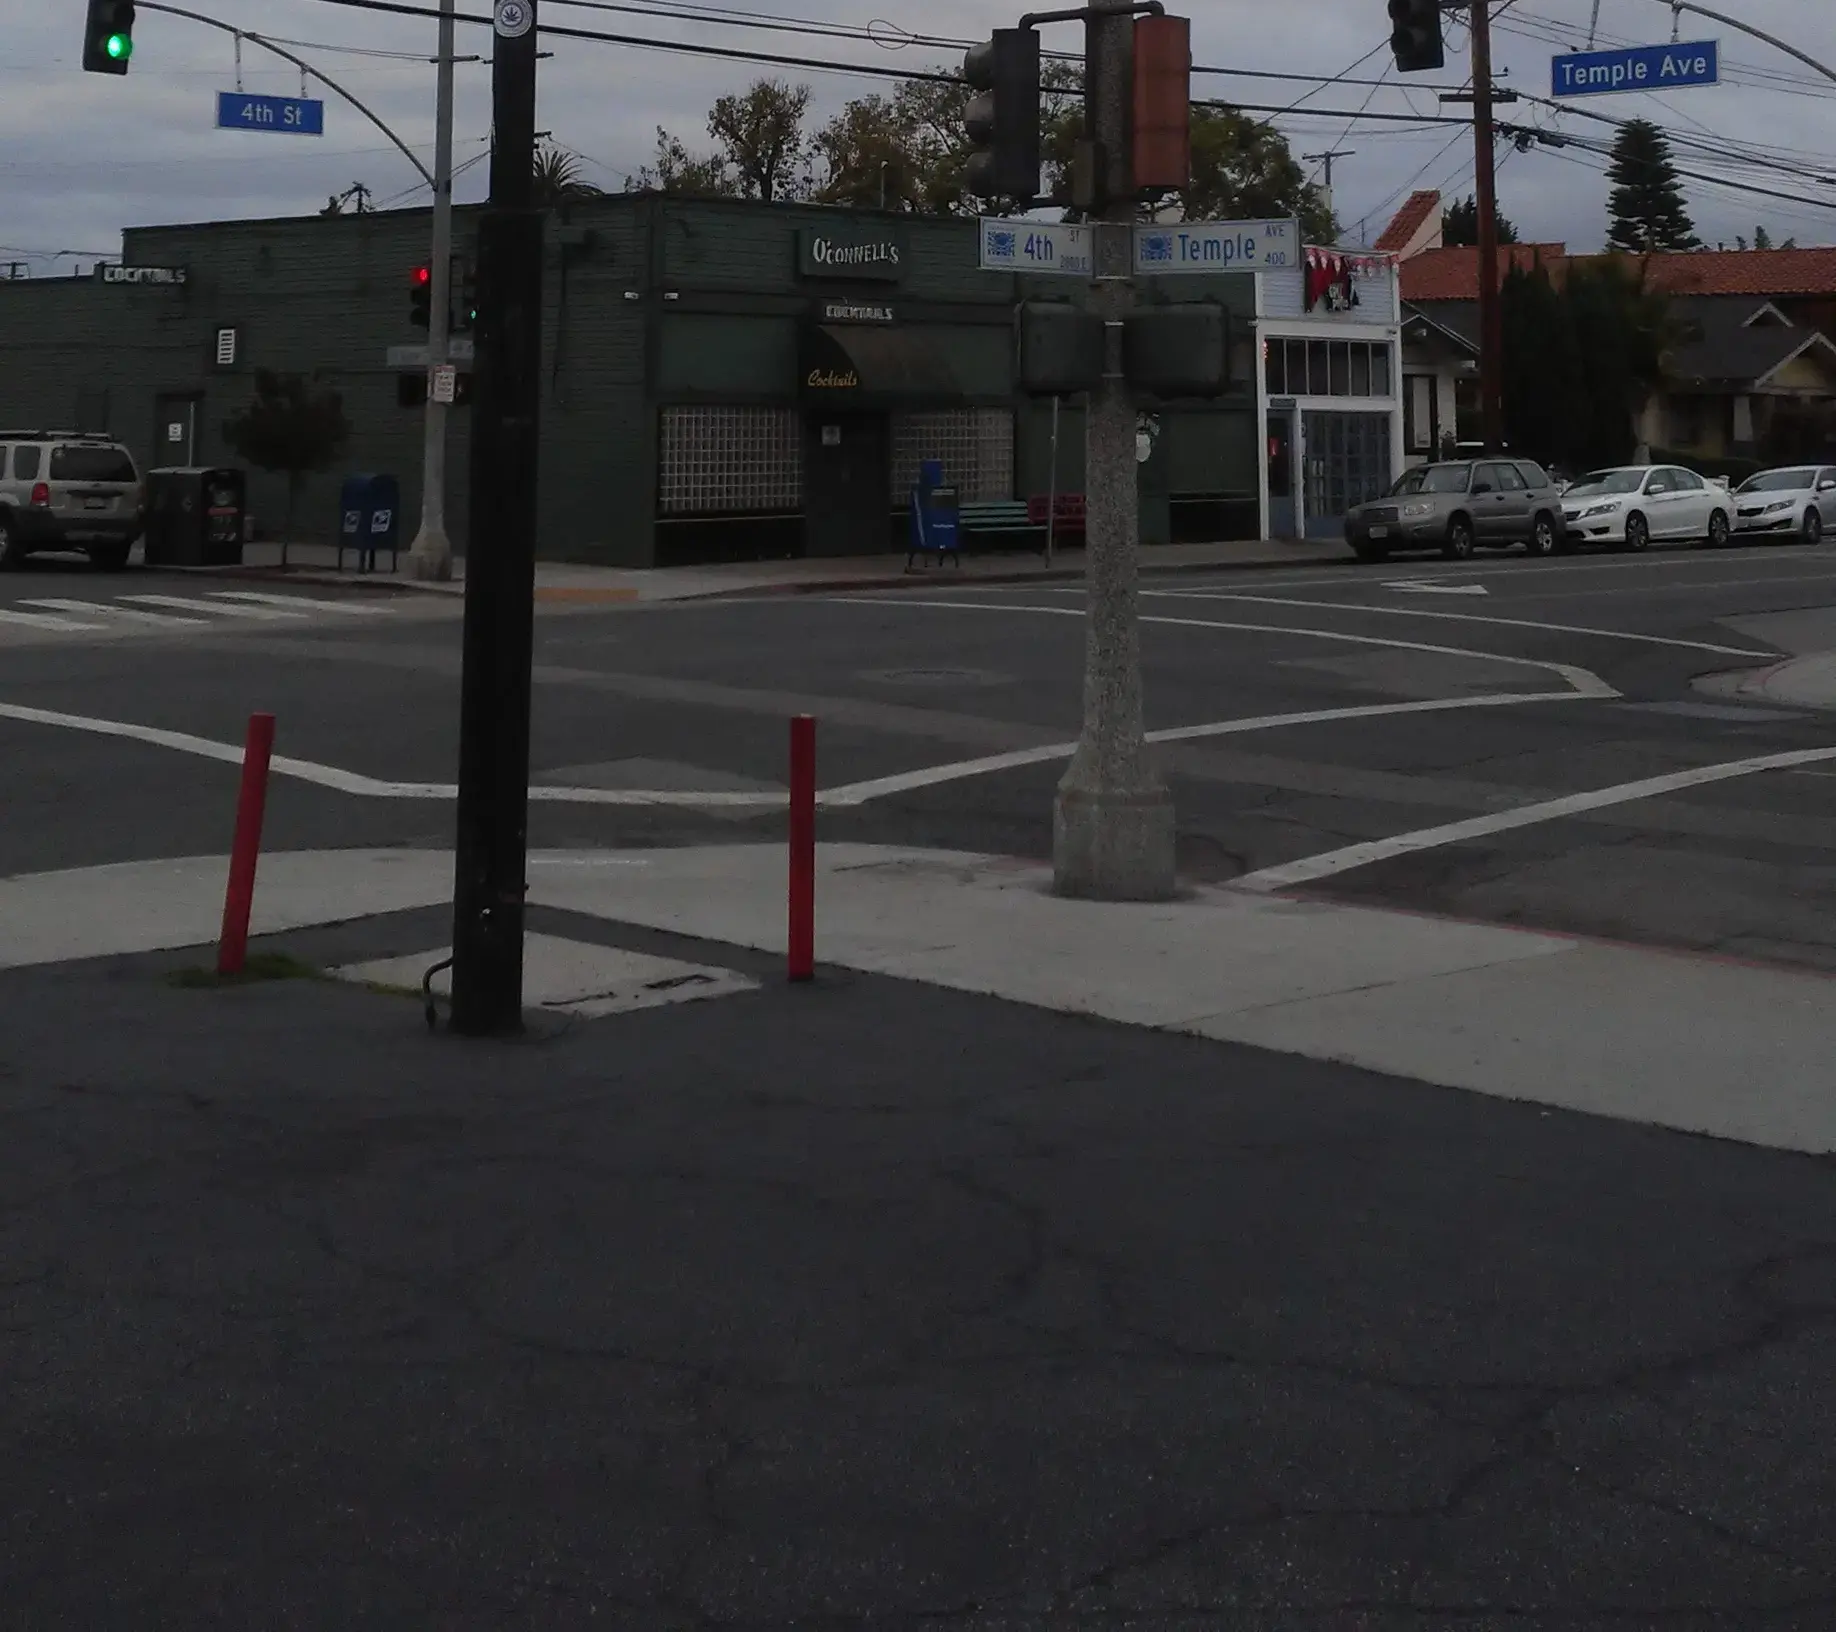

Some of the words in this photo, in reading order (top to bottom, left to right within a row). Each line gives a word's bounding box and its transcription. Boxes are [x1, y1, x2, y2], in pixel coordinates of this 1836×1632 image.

[1561, 58, 1648, 87] Temple
[1659, 54, 1706, 78] Ave
[241, 102, 273, 123] 4th
[283, 105, 303, 125] St
[1023, 232, 1053, 261] 4th
[1069, 229, 1080, 243] ST
[1178, 234, 1255, 266] Temple
[1264, 225, 1285, 238] AVE
[1264, 252, 1286, 266] 400
